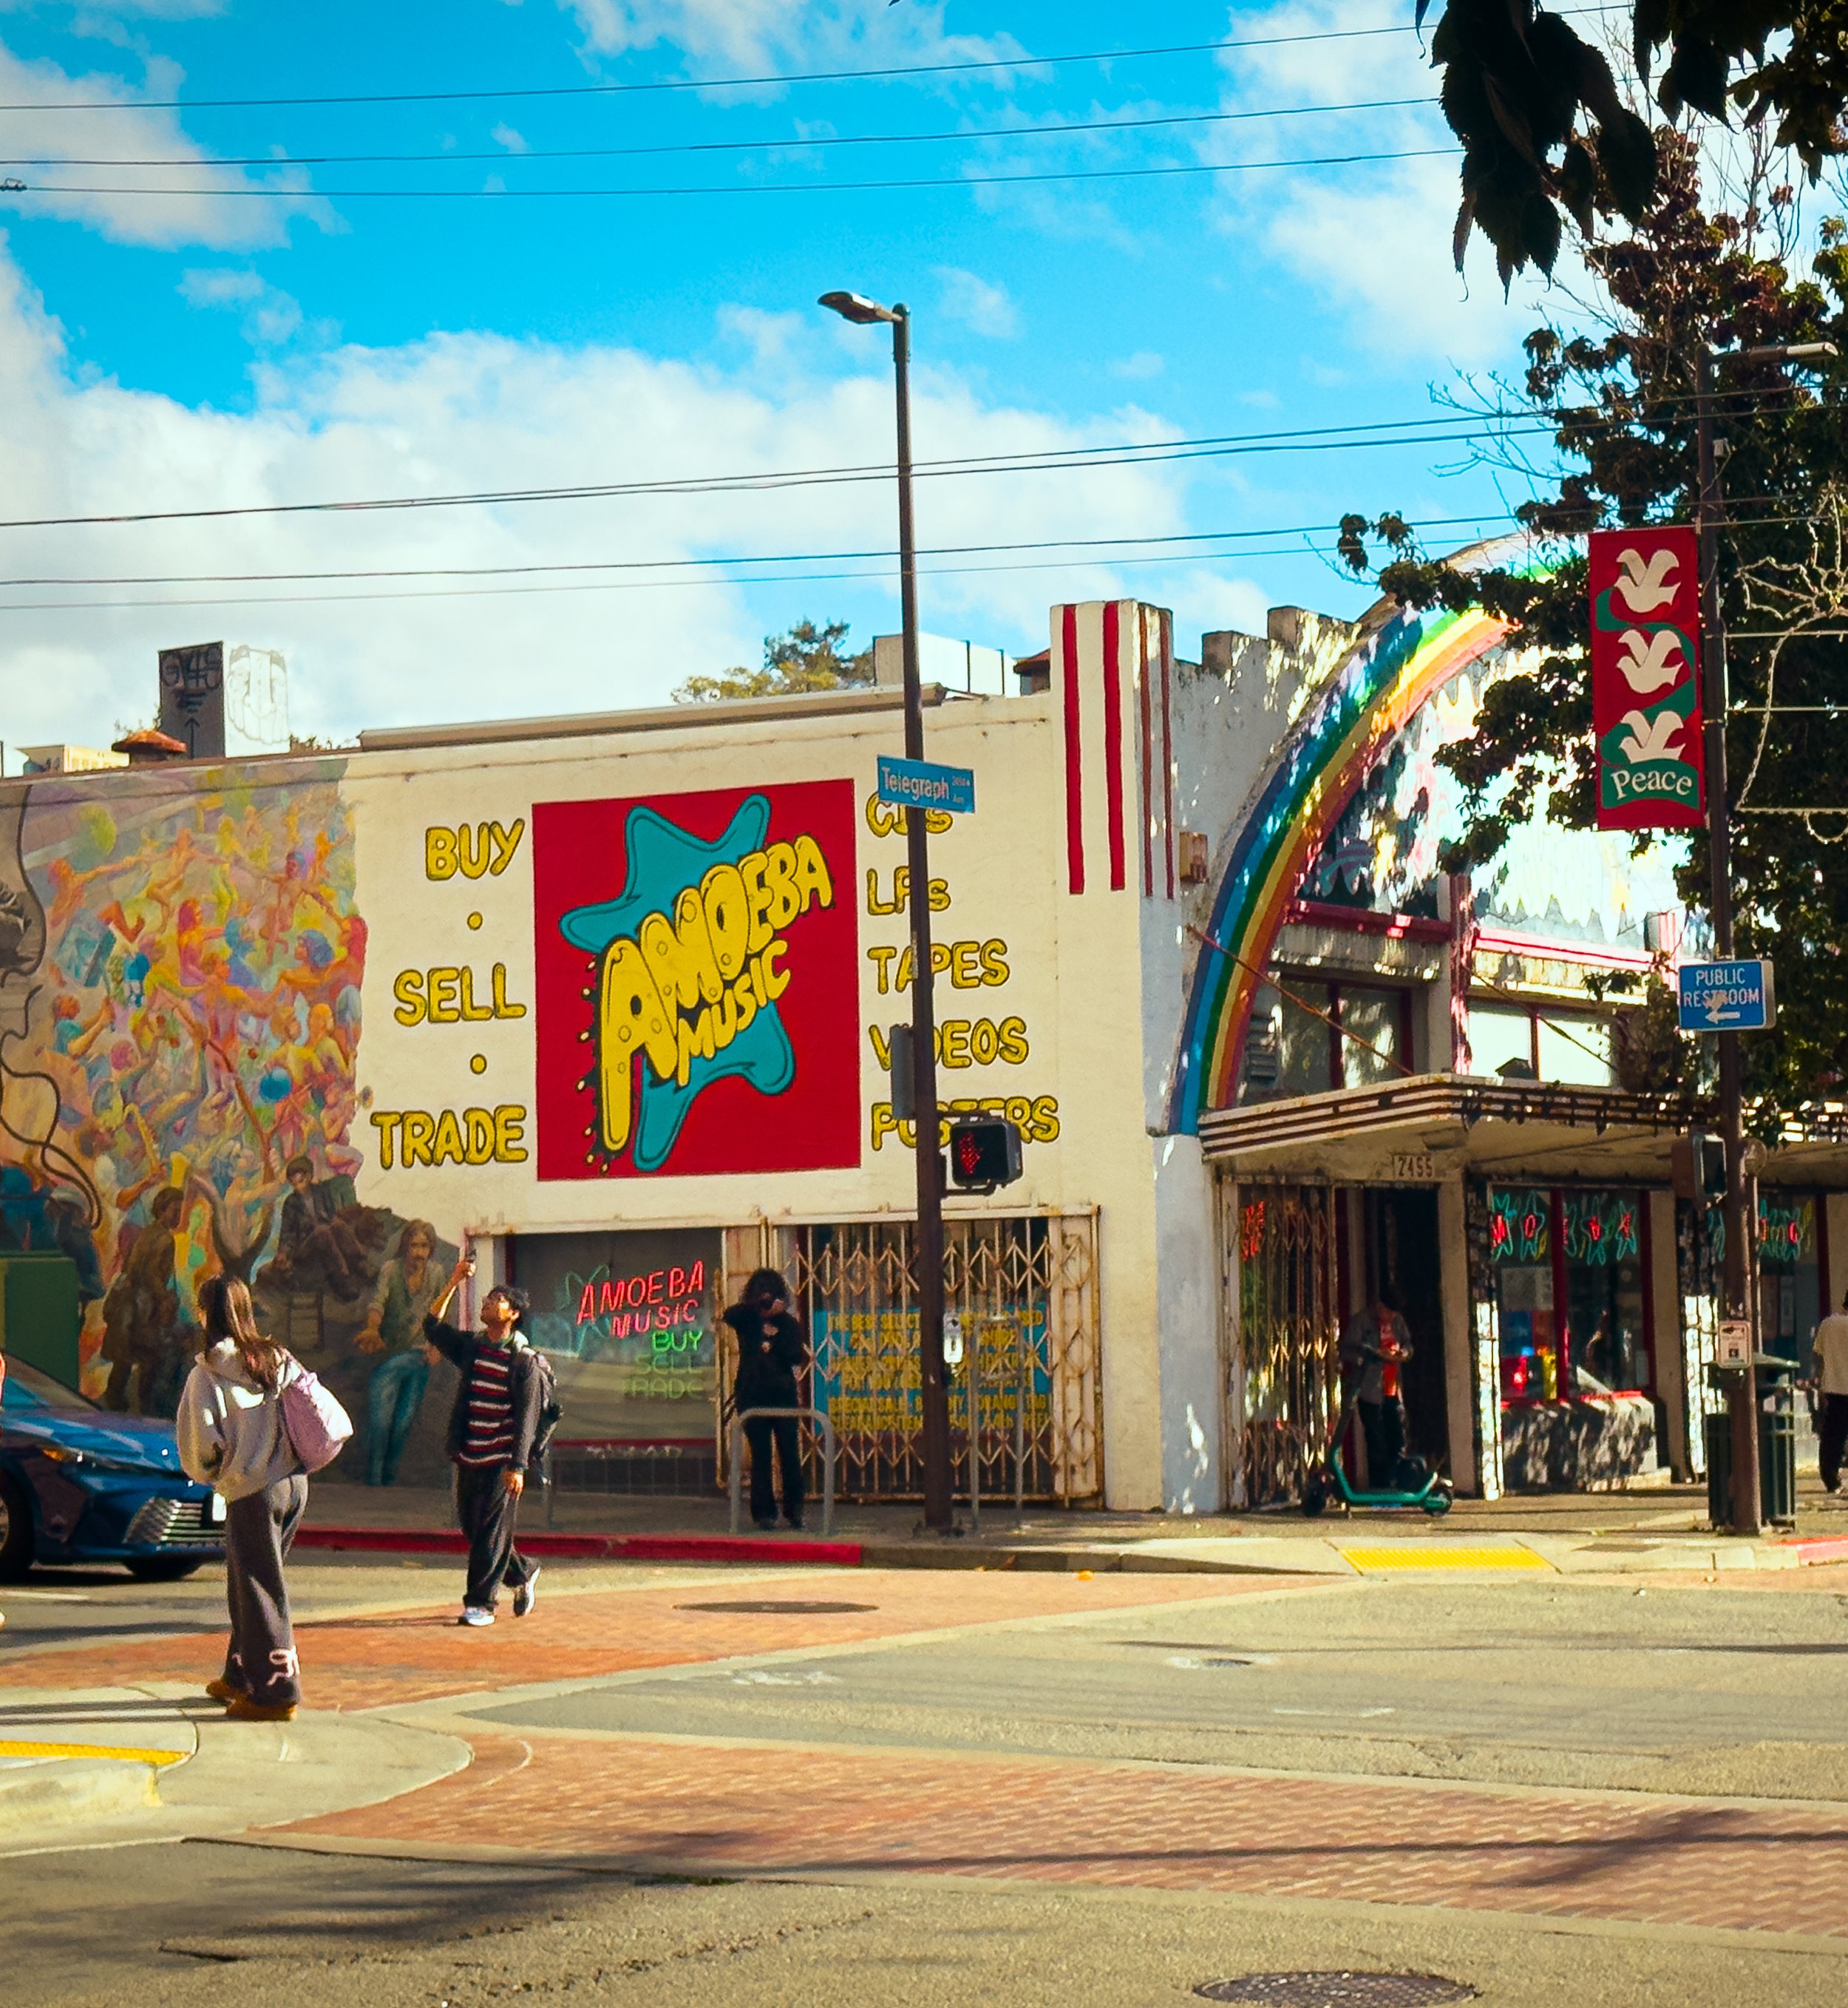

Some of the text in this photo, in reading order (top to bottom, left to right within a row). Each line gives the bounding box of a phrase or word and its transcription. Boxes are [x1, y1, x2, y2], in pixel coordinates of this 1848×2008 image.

[881, 766, 950, 803] Telegraph
[1610, 770, 1693, 799] Peace
[425, 818, 525, 881] BUY
[393, 963, 526, 1026] SELL
[600, 832, 834, 1153] AMOEBA
[1683, 987, 1760, 1008] RESOOM
[1695, 967, 1746, 987] PUBLIC
[676, 939, 792, 1088] MUSIC
[869, 1016, 1029, 1071] VEOS
[370, 1105, 529, 1169] TRADE
[1398, 1156, 1433, 1178] 2455
[577, 1258, 704, 1326] AMOEBA
[610, 1298, 699, 1340] MUSIC
[651, 1329, 704, 1352] BUY
